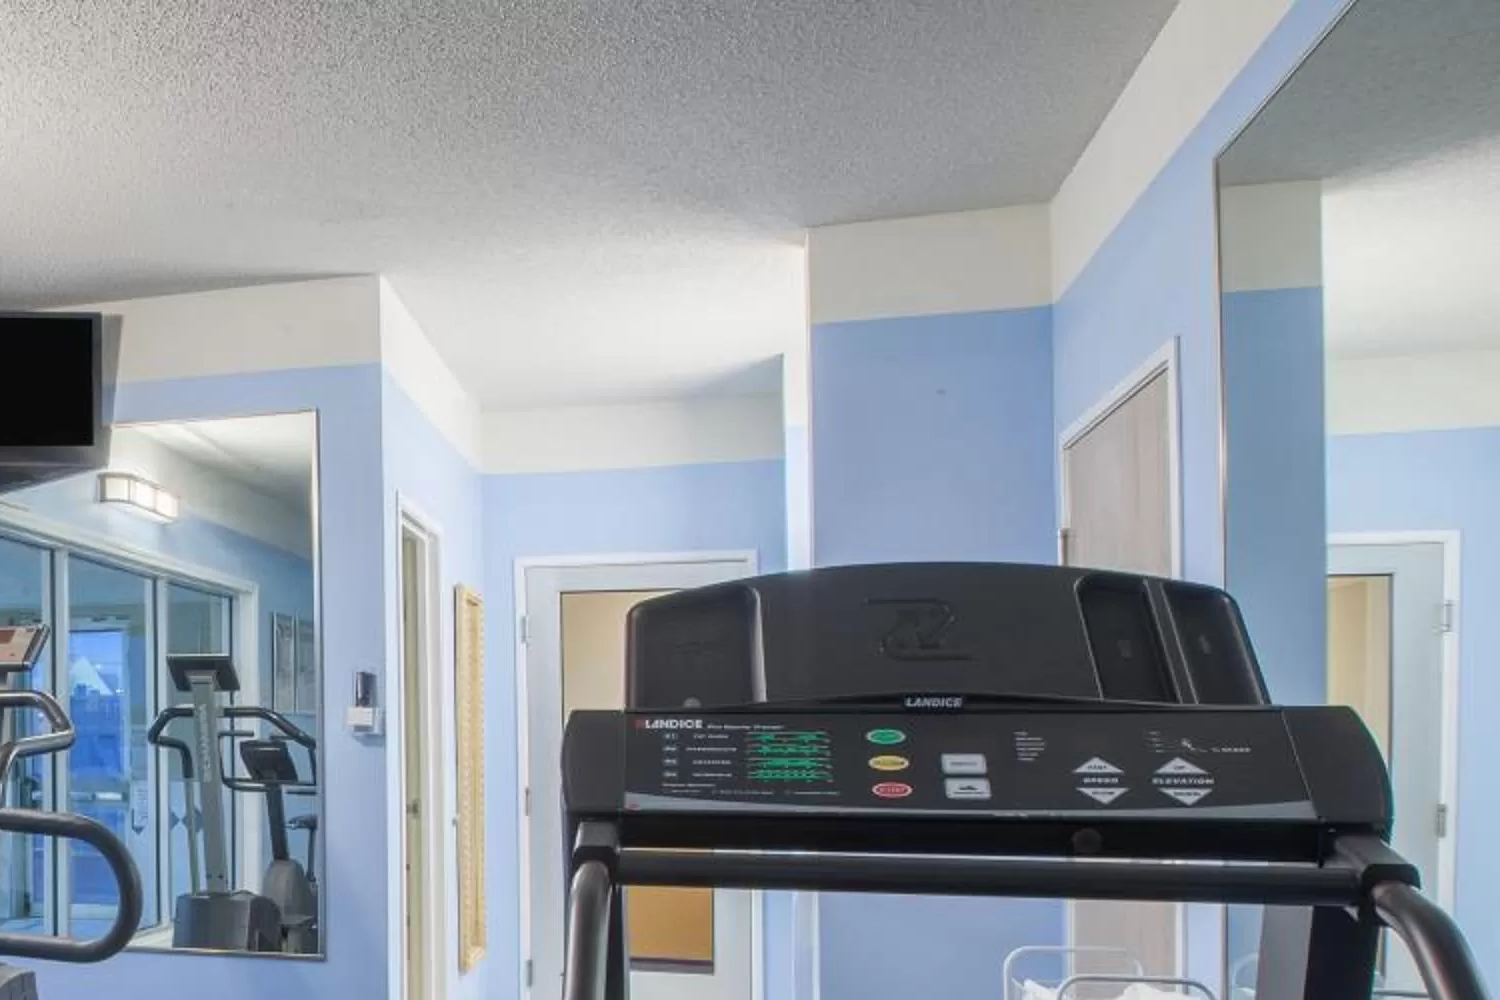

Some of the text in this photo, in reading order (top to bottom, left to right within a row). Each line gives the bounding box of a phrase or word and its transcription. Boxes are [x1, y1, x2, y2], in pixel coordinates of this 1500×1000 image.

[904, 697, 963, 708] LANDICE
[644, 719, 703, 729] LANDICE
[1152, 776, 1216, 786] ELEVATION
